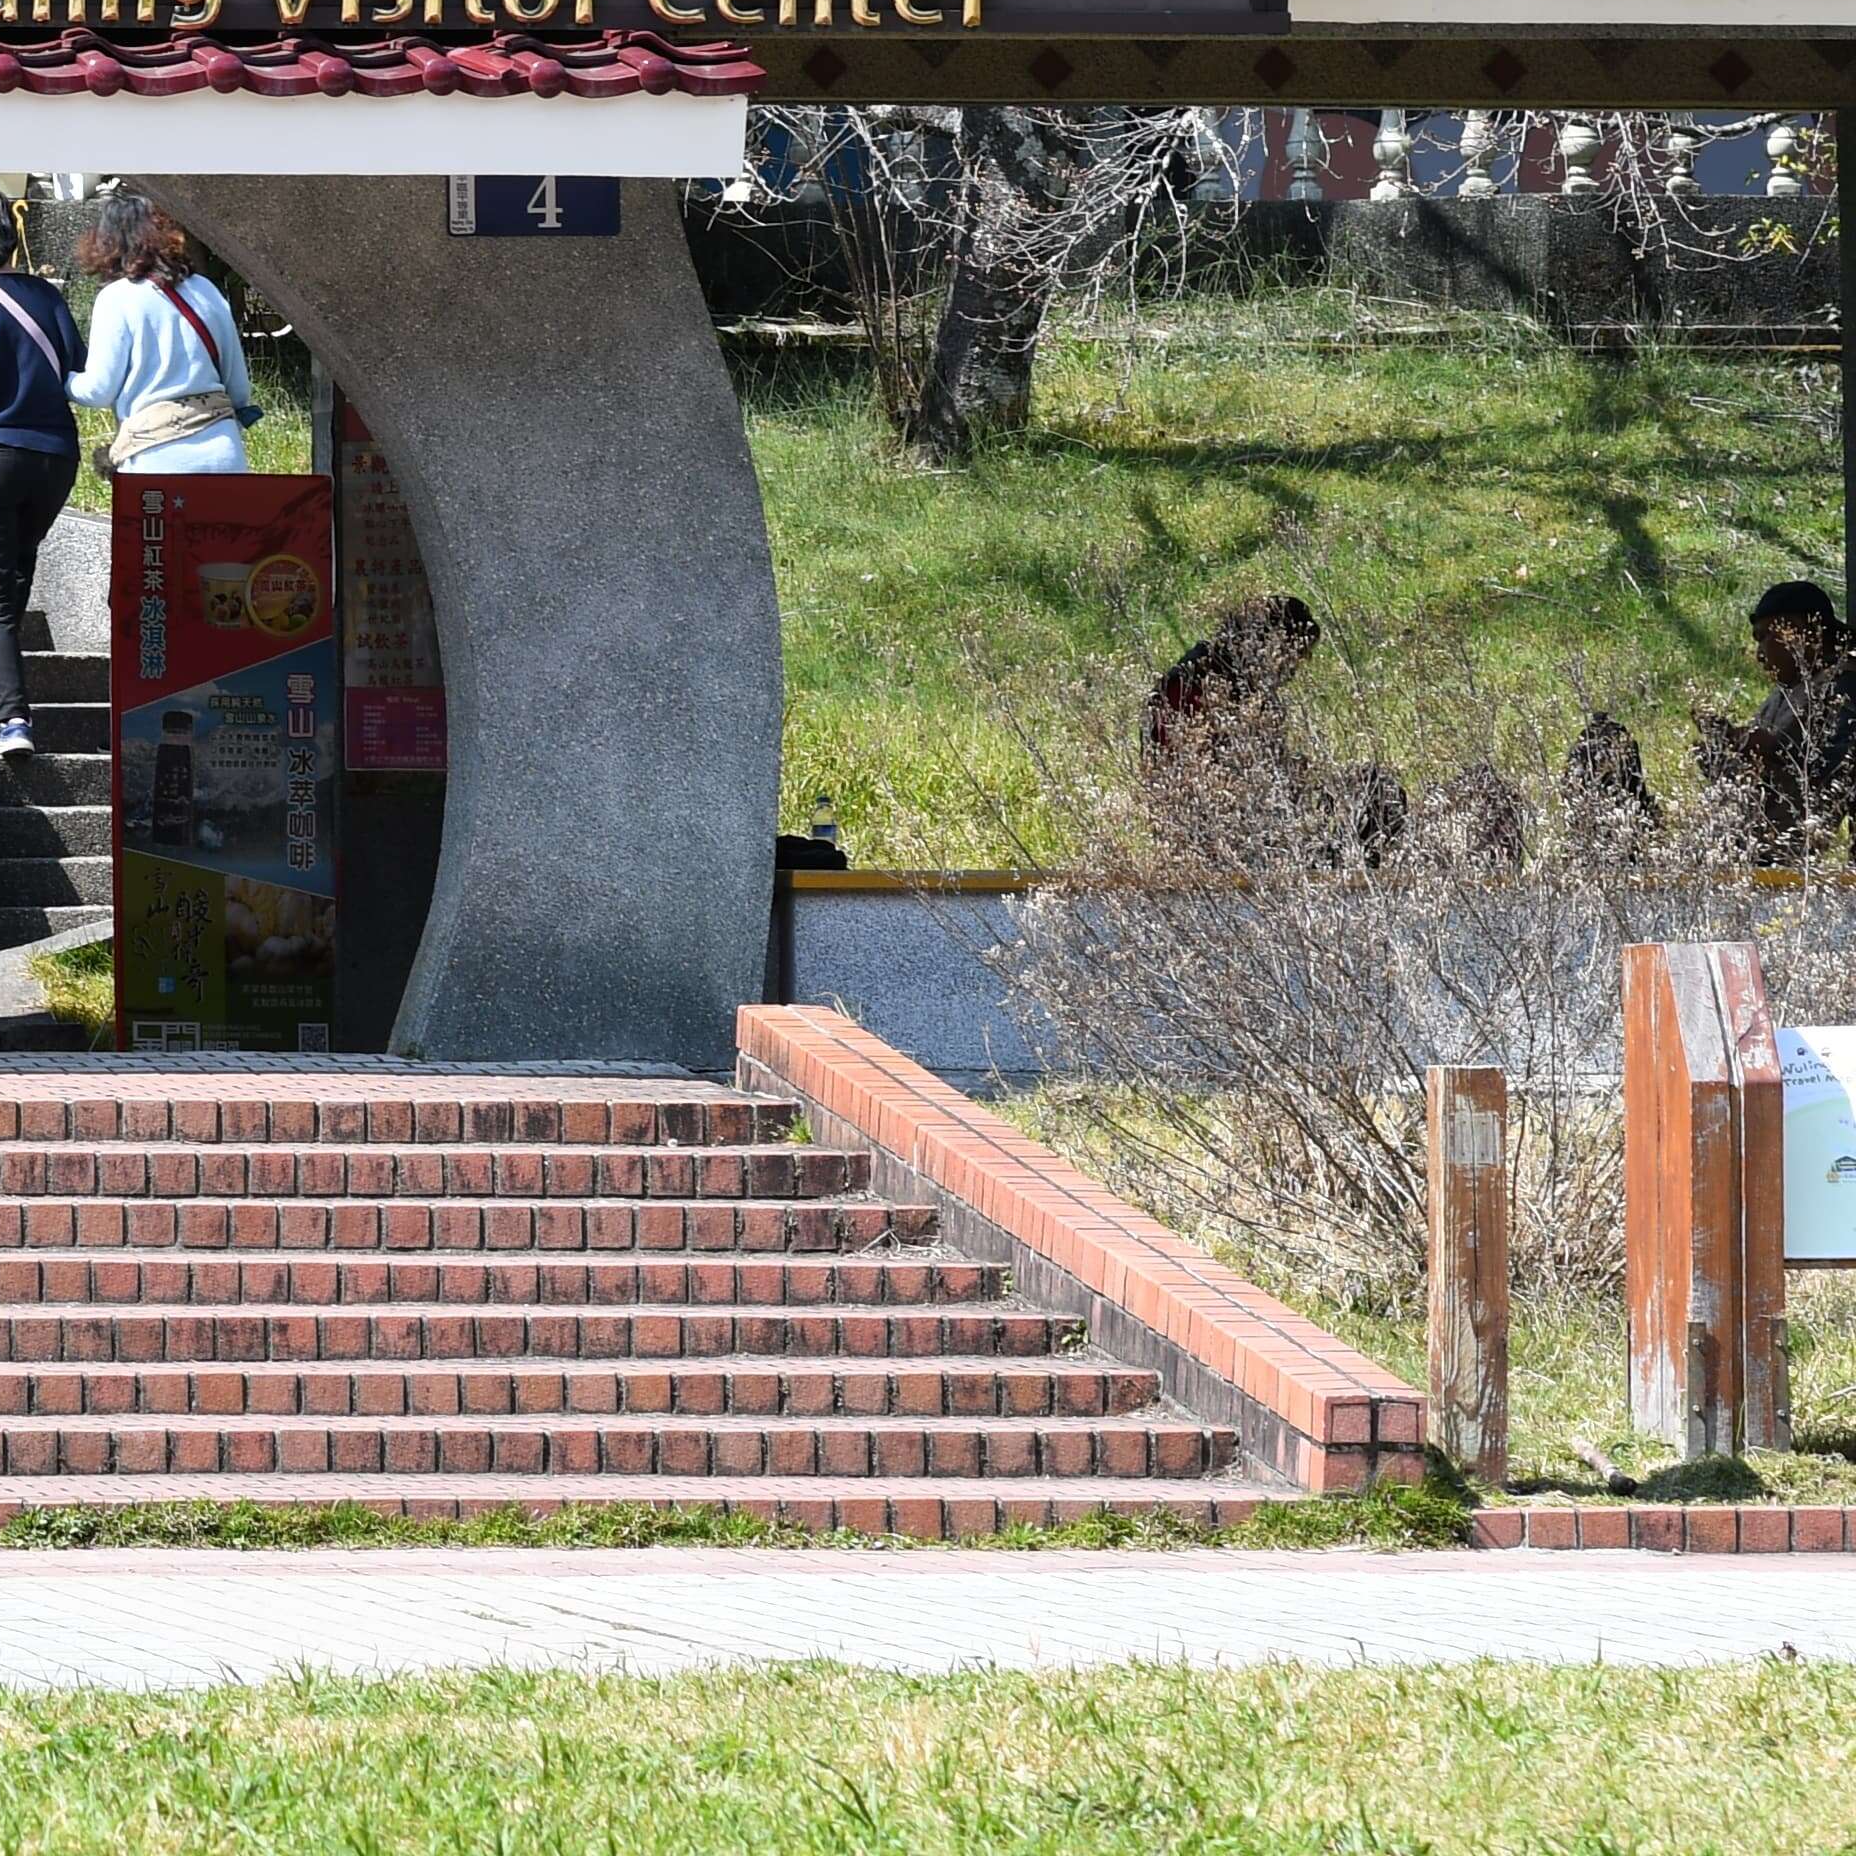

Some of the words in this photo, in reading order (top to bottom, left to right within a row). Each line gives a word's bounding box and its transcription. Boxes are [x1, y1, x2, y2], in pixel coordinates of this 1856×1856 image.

[526, 175, 563, 228] 4
[141, 490, 166, 679] 雪山紅茶冰淇淋
[287, 674, 316, 870] 雪山冰萃咖啡
